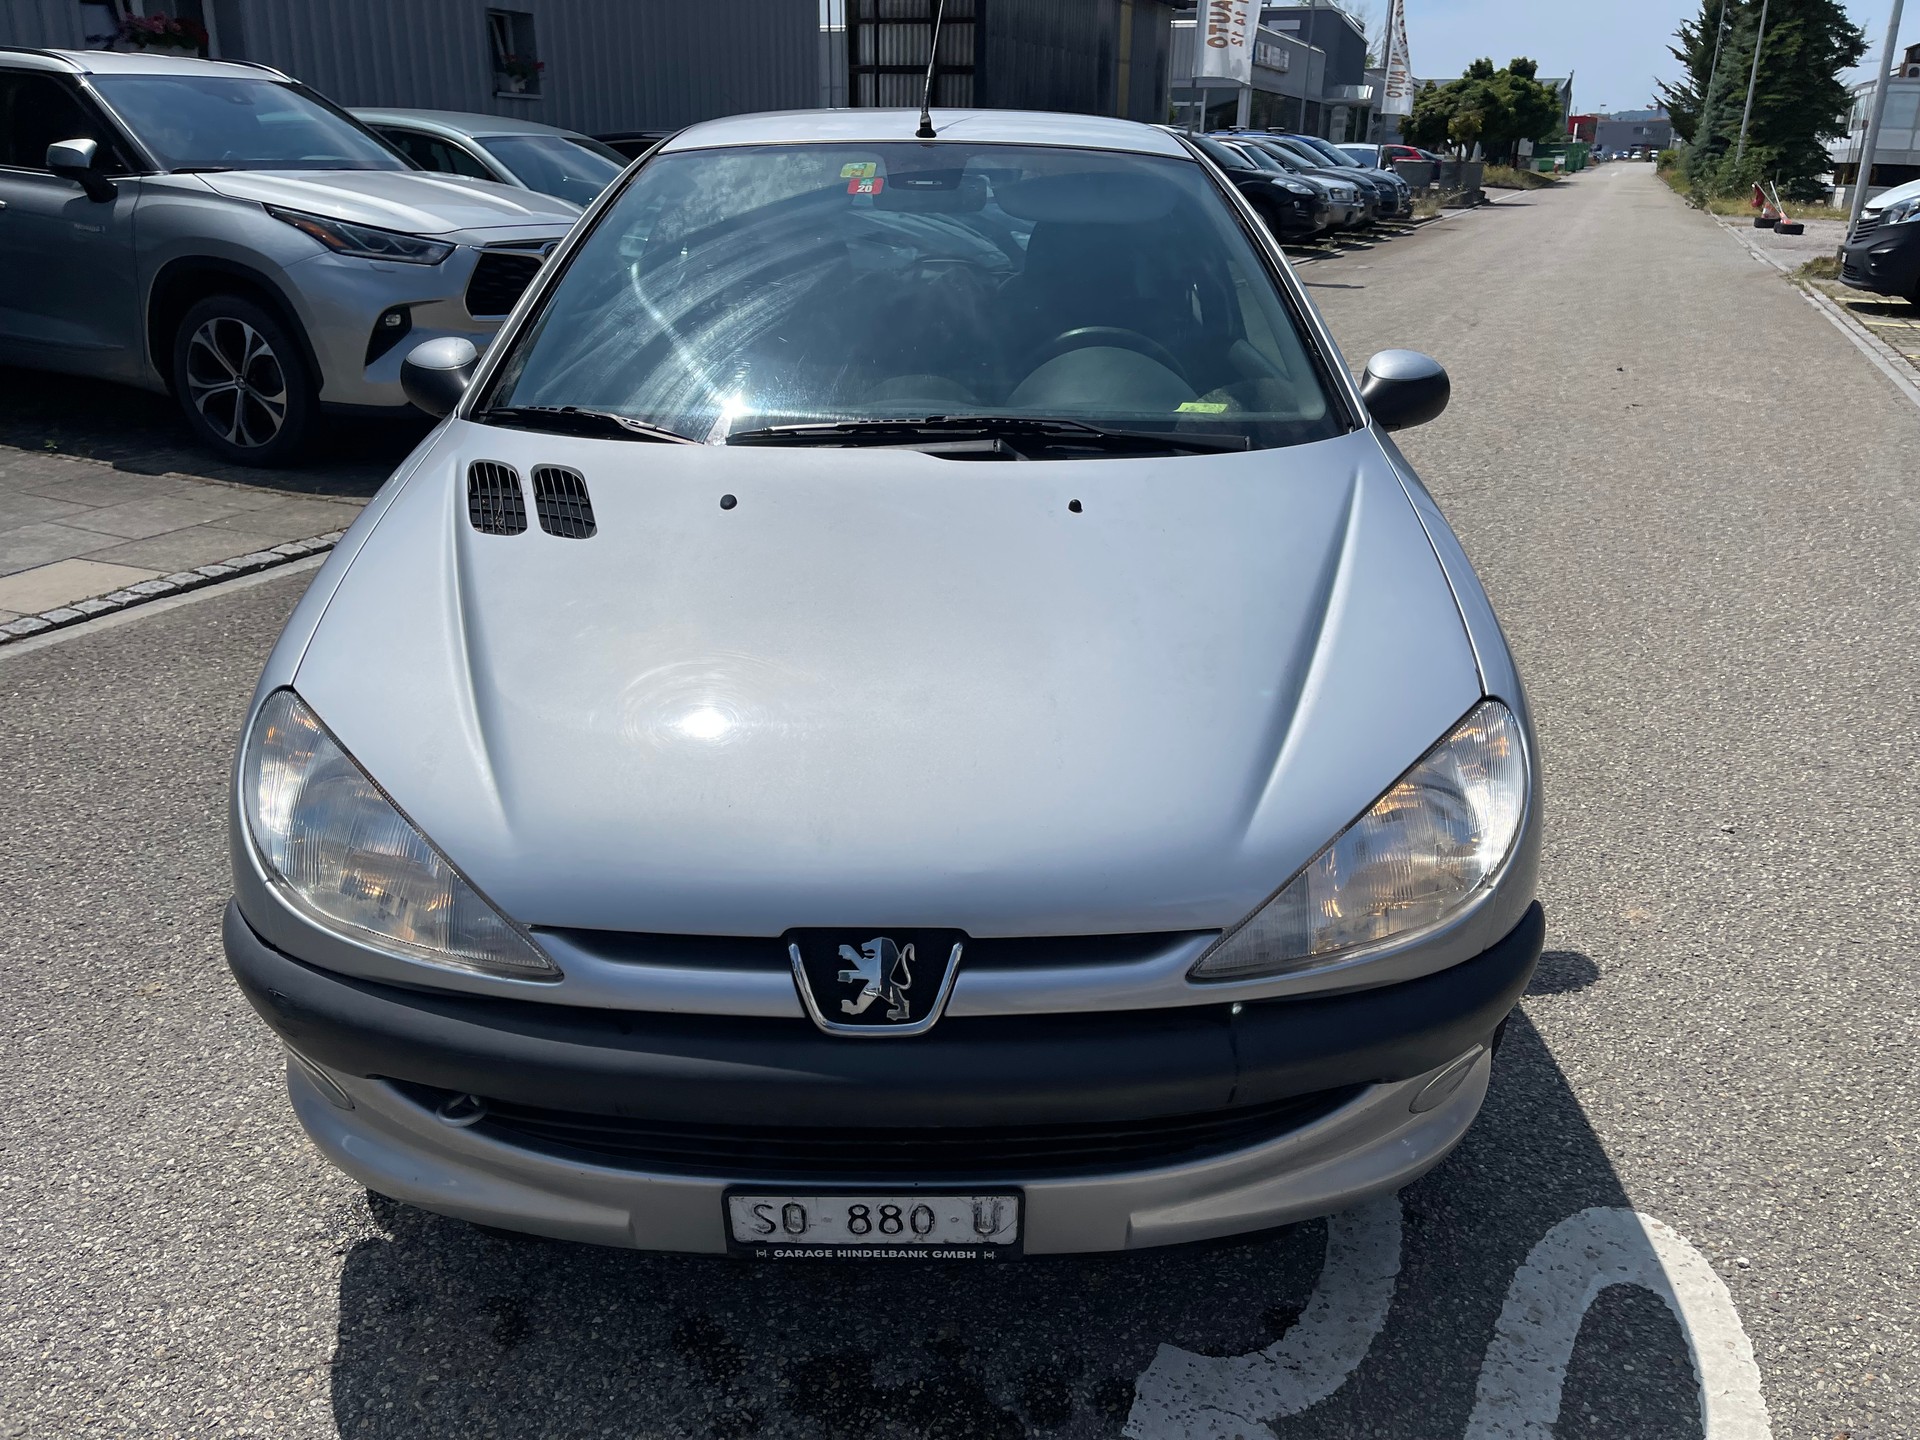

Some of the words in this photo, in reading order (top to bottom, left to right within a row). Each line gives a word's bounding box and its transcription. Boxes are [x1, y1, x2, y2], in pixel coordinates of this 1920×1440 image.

[857, 184, 873, 193] 20
[753, 1202, 807, 1236] SO
[848, 1203, 936, 1236] 880
[774, 1250, 833, 1259] GARAGE
[837, 1250, 928, 1259] HINDELBANK
[932, 1250, 977, 1260] GMBH
